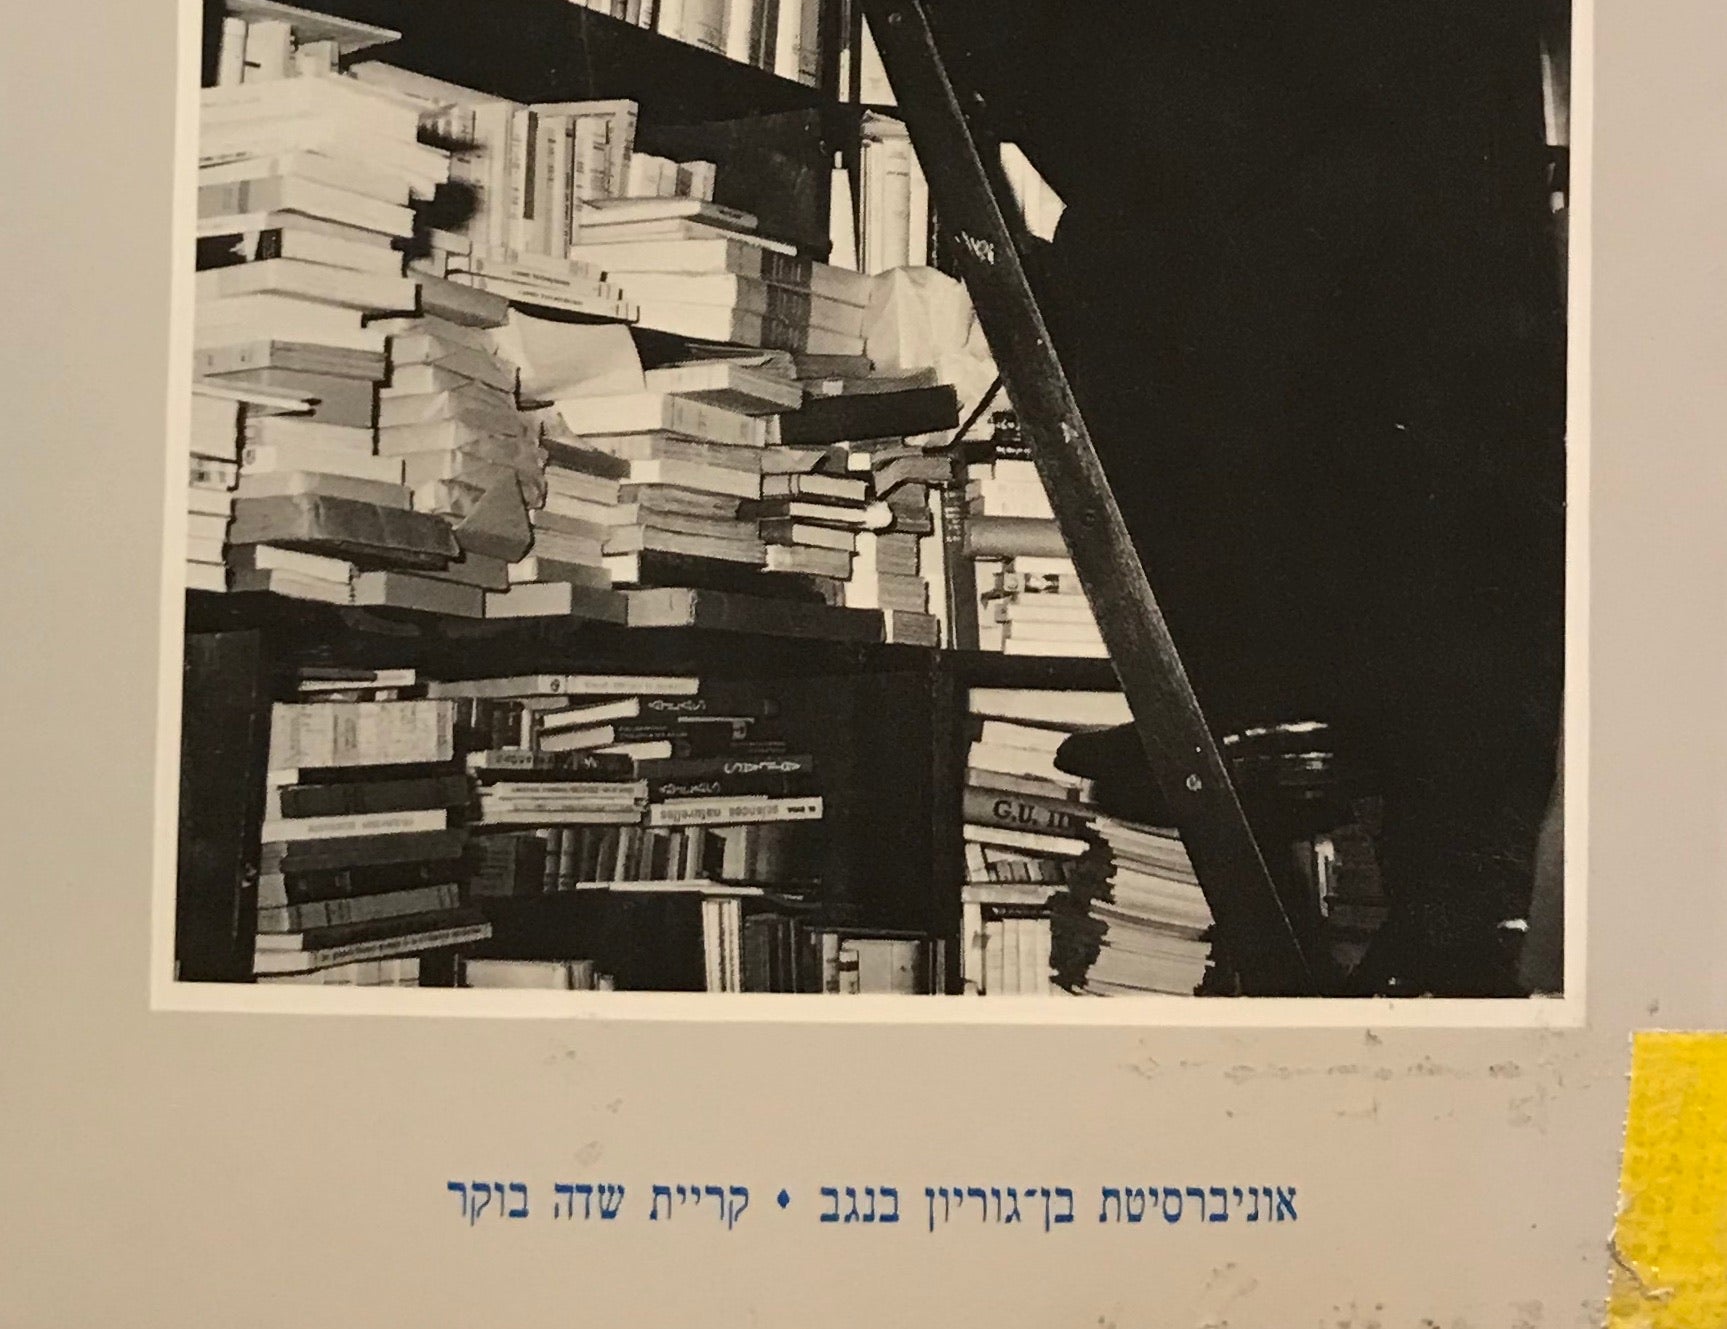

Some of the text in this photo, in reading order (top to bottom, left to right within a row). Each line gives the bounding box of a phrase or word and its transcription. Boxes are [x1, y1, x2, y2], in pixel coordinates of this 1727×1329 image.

[447, 1181, 1297, 1231] אוניברסיטת בן־גוריון בנגב קריית שדה בוקר
